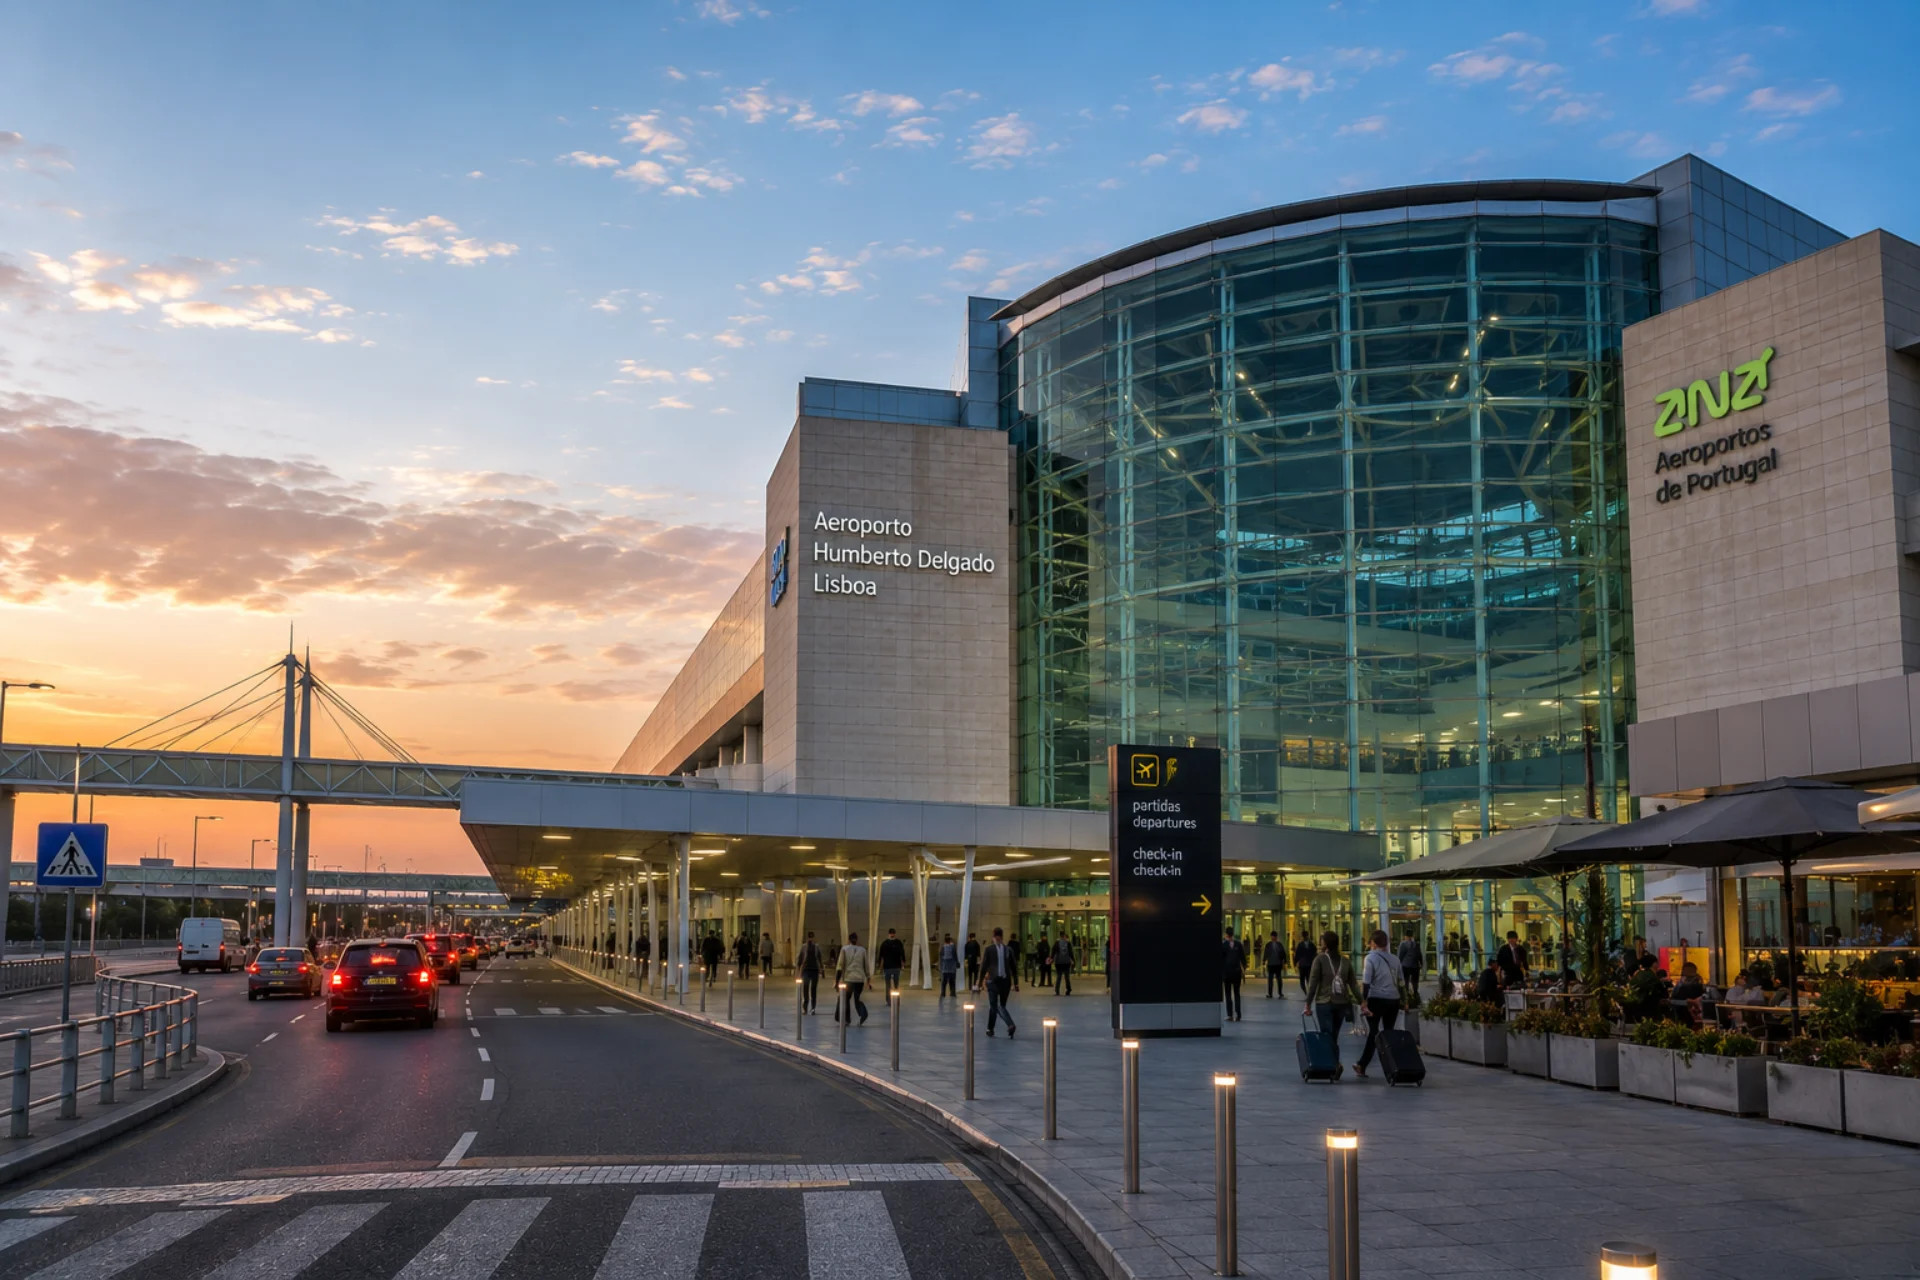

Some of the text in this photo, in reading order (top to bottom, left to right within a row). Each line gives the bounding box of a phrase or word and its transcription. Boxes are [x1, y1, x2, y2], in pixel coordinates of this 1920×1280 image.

[1655, 424, 1772, 474] Aeroportos
[1656, 447, 1777, 504] de Portugal
[814, 511, 912, 538] Aeroporto
[814, 542, 995, 576] Humberto Delgado
[814, 572, 877, 596] Lisboa
[1133, 799, 1181, 813] partidas
[1133, 815, 1197, 831] departures
[1133, 846, 1182, 861] check-in
[1133, 862, 1181, 876] check-in
